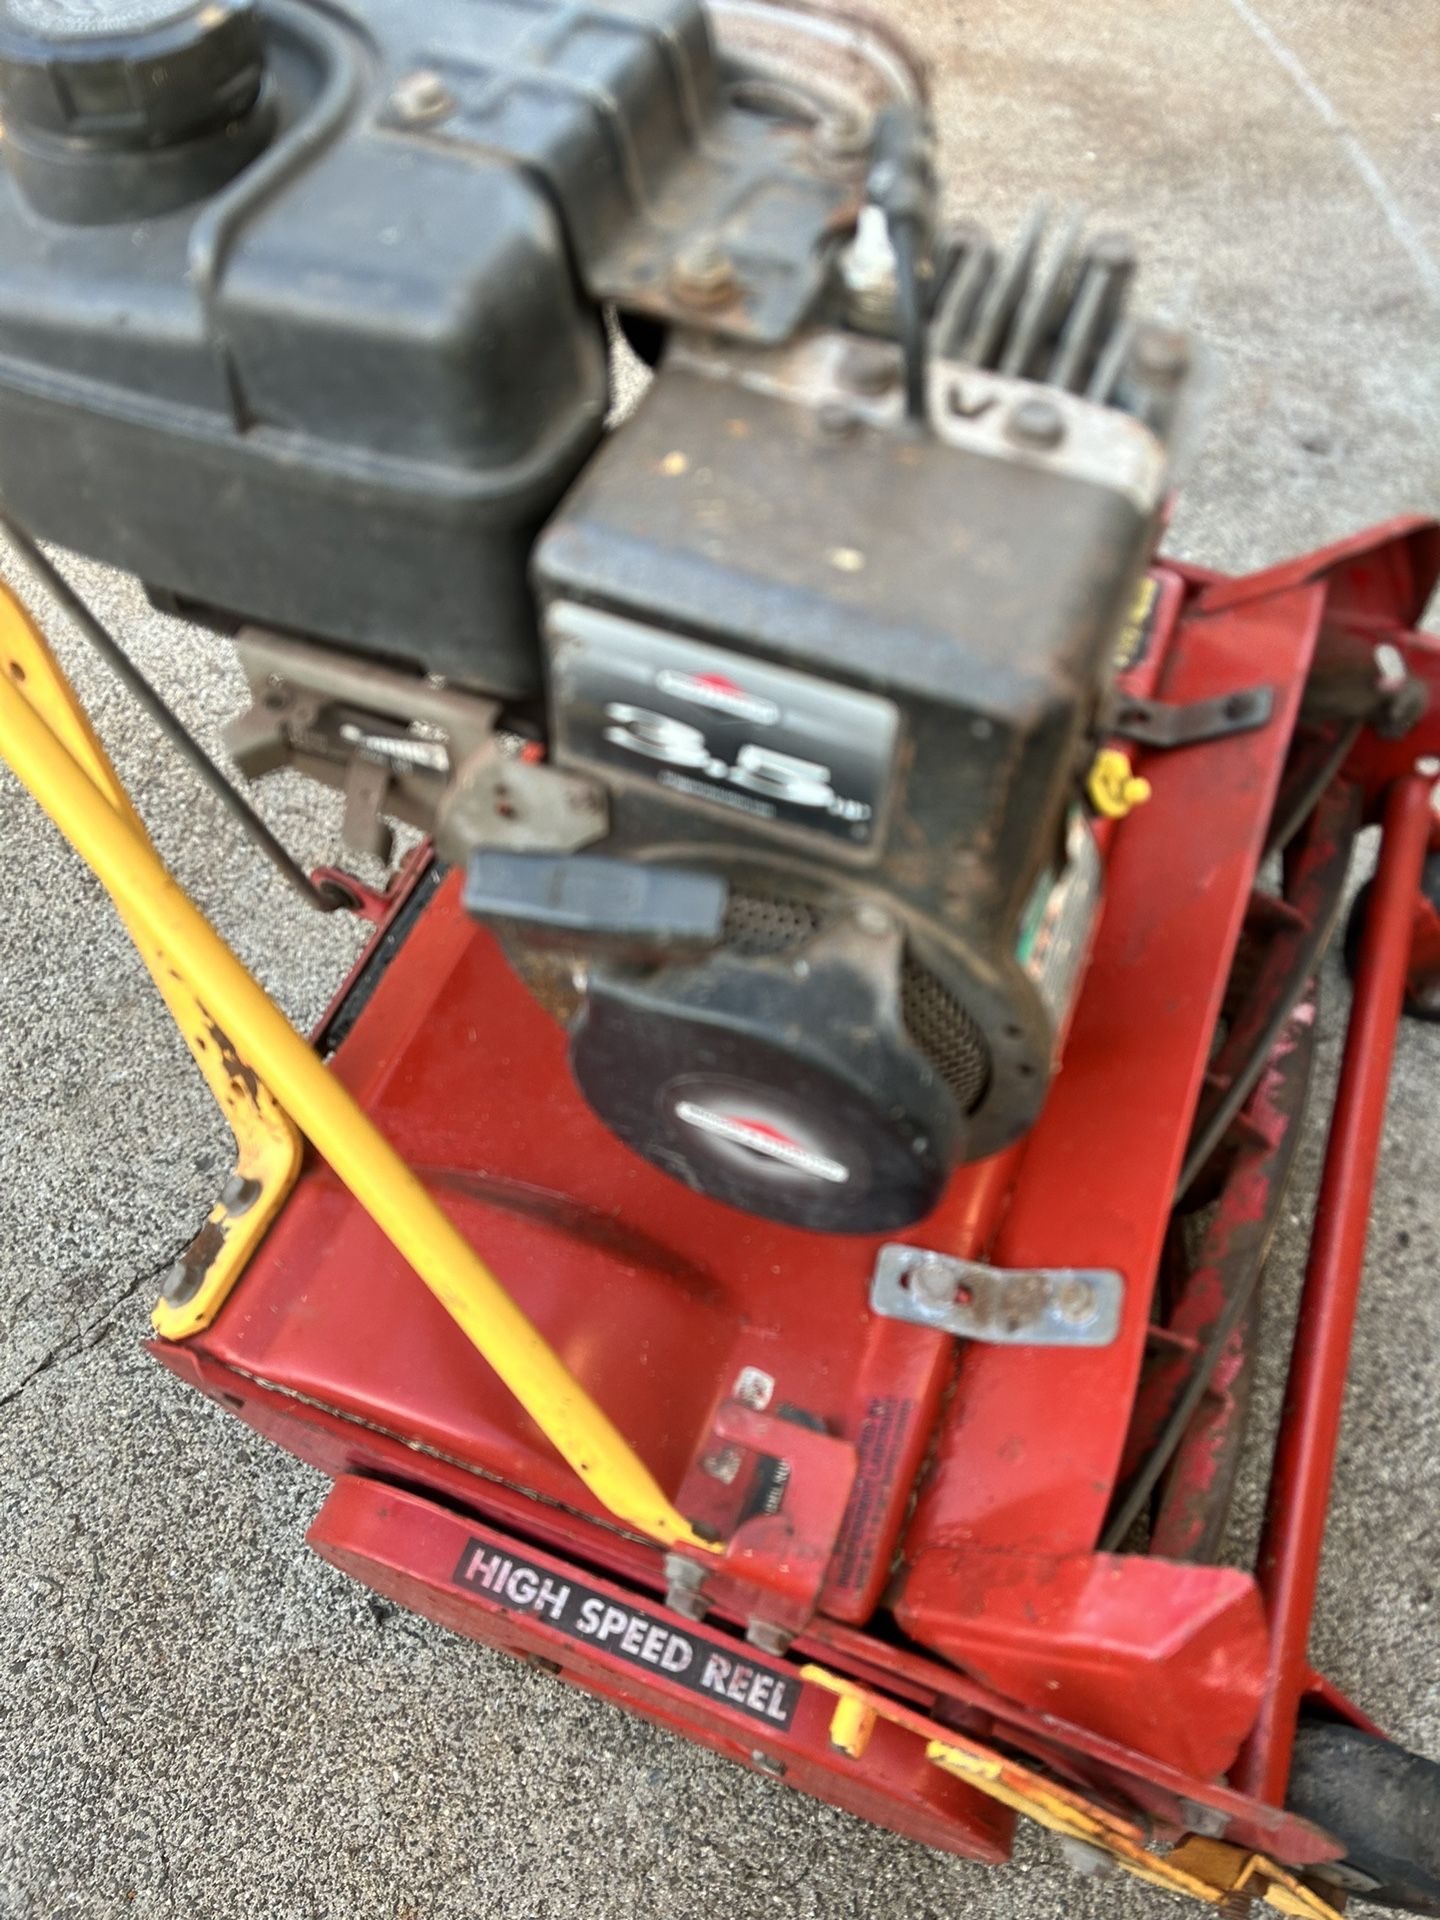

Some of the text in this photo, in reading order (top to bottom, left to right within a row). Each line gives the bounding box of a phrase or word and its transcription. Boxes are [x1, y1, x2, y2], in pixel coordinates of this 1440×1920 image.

[603, 702, 836, 808] 3.5
[464, 1547, 787, 1721] HIGH SPEED REEL
